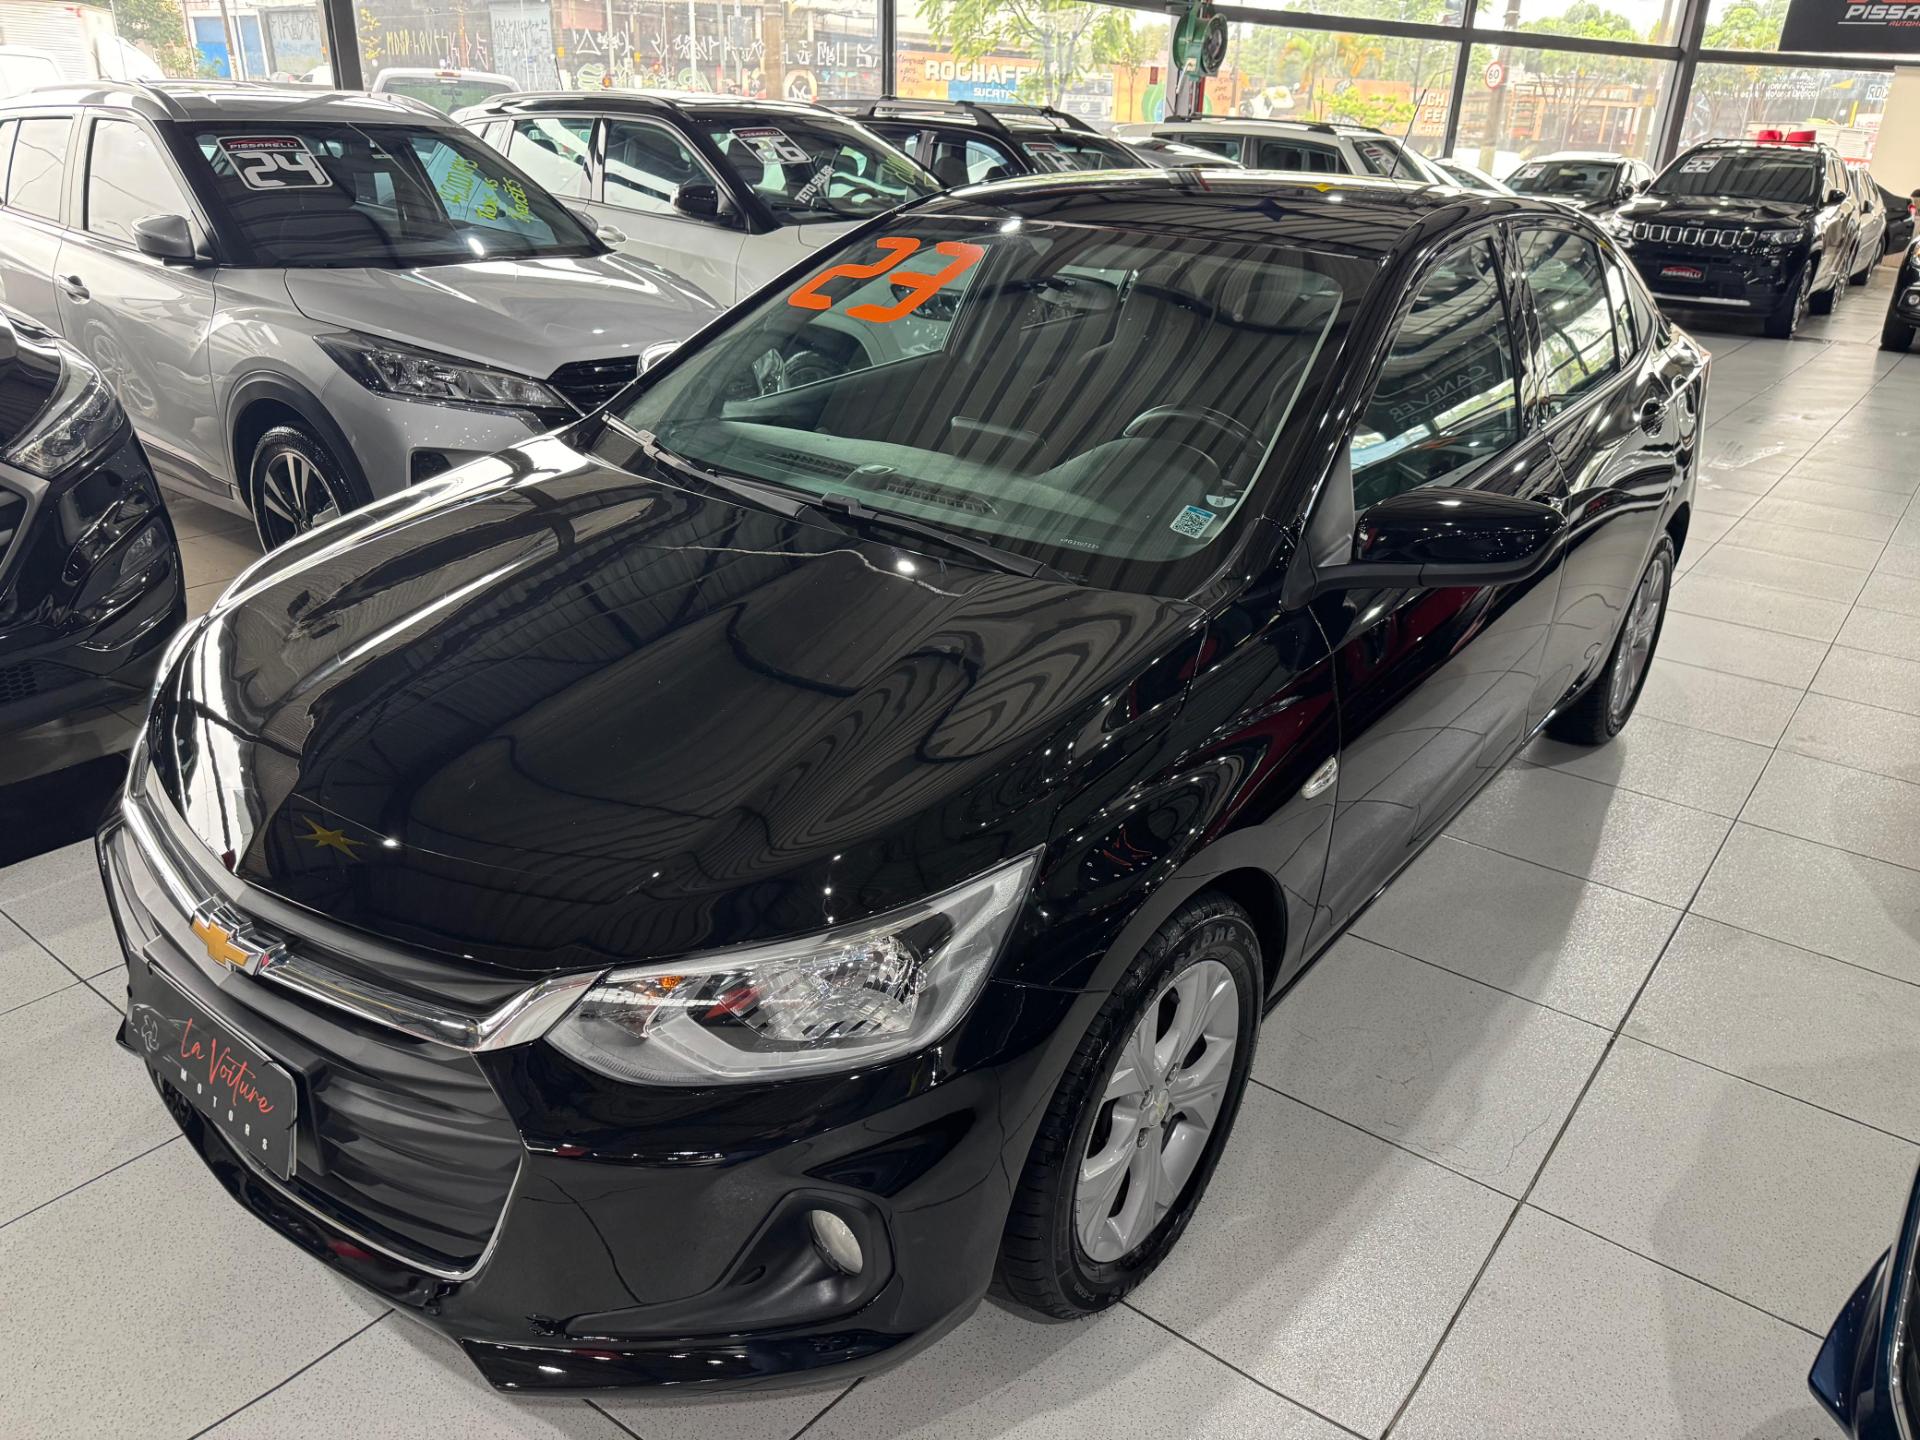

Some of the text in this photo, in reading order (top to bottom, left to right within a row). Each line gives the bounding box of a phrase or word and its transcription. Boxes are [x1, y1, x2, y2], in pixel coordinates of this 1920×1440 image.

[925, 59, 1038, 86] ROCHAFE
[1488, 69, 1500, 80] 60
[229, 142, 298, 150] PISSARELLI
[236, 151, 326, 187] 24
[1683, 160, 1715, 172] 22
[788, 236, 985, 323] 23
[180, 1017, 275, 1114] La Voiture
[180, 1067, 269, 1151] MOTORS
